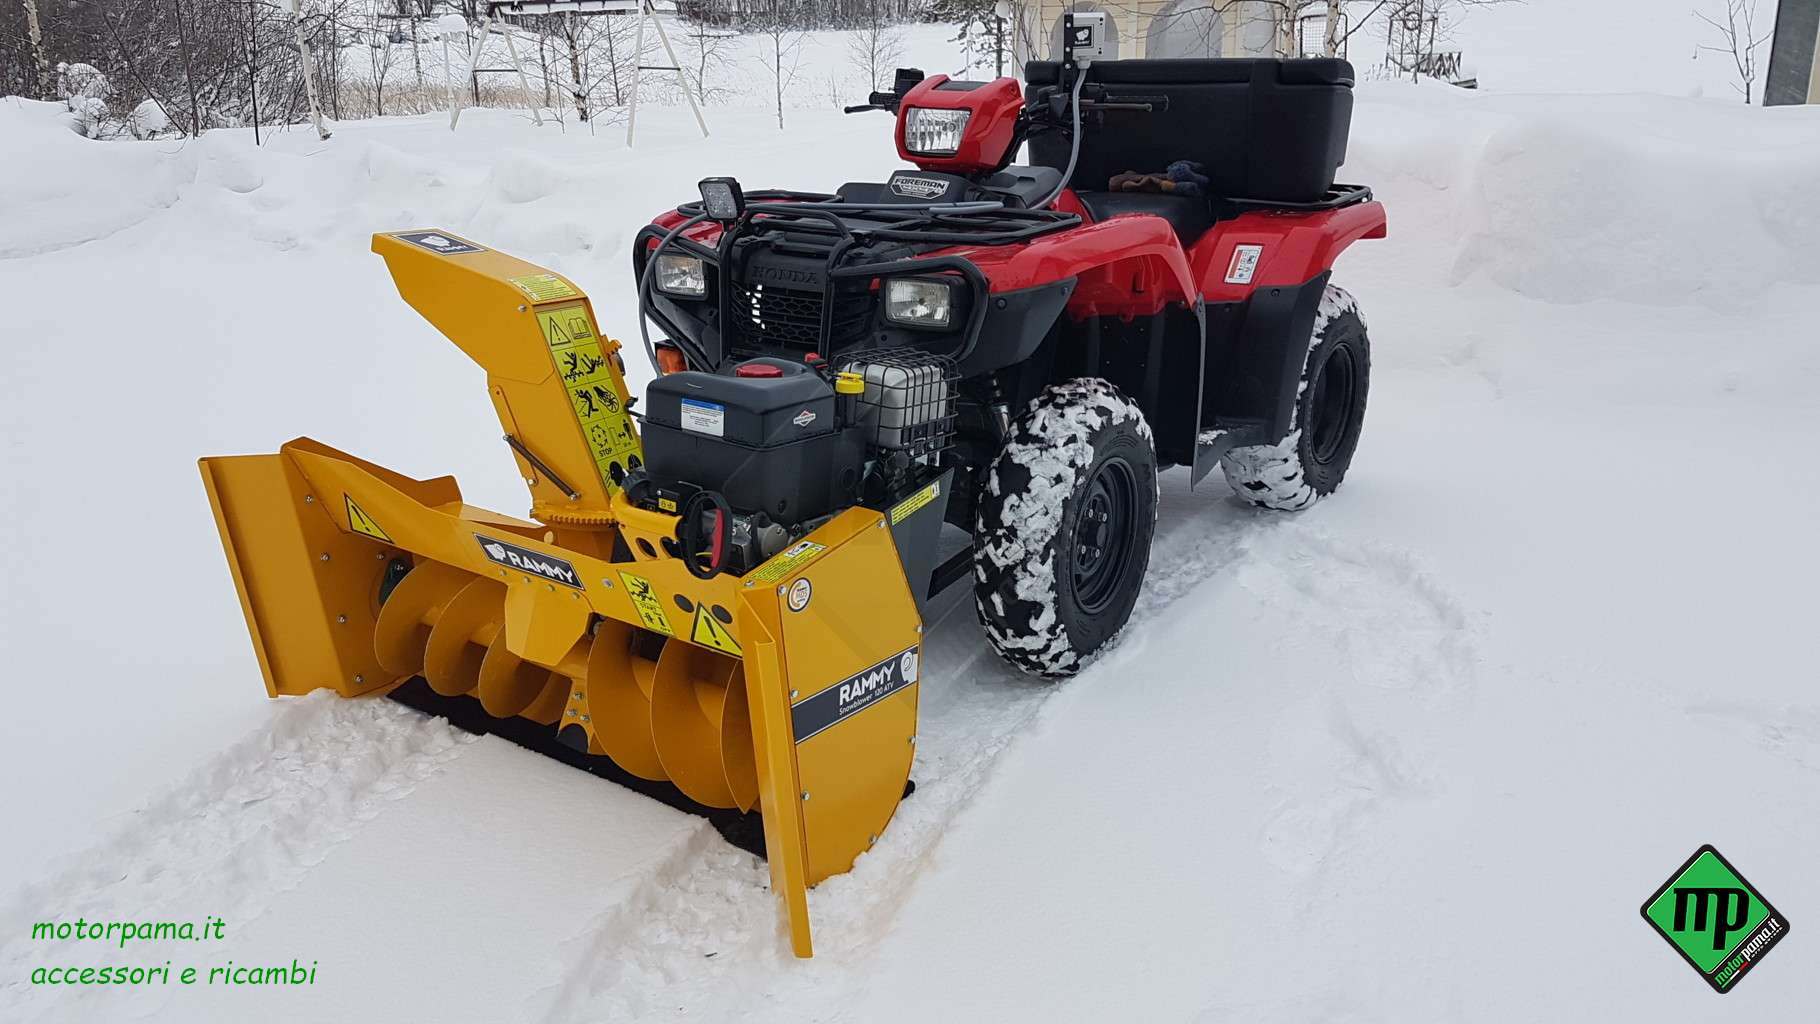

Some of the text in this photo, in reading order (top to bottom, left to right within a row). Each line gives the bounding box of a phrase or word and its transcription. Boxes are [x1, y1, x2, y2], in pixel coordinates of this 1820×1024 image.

[894, 178, 946, 189] FOREMAN
[752, 265, 817, 284] HONDA
[599, 447, 613, 458] STOP
[506, 550, 574, 584] RAMMY
[839, 660, 896, 706] RAMMY
[839, 693, 873, 716] Snowblower
[884, 681, 895, 692] ATV
